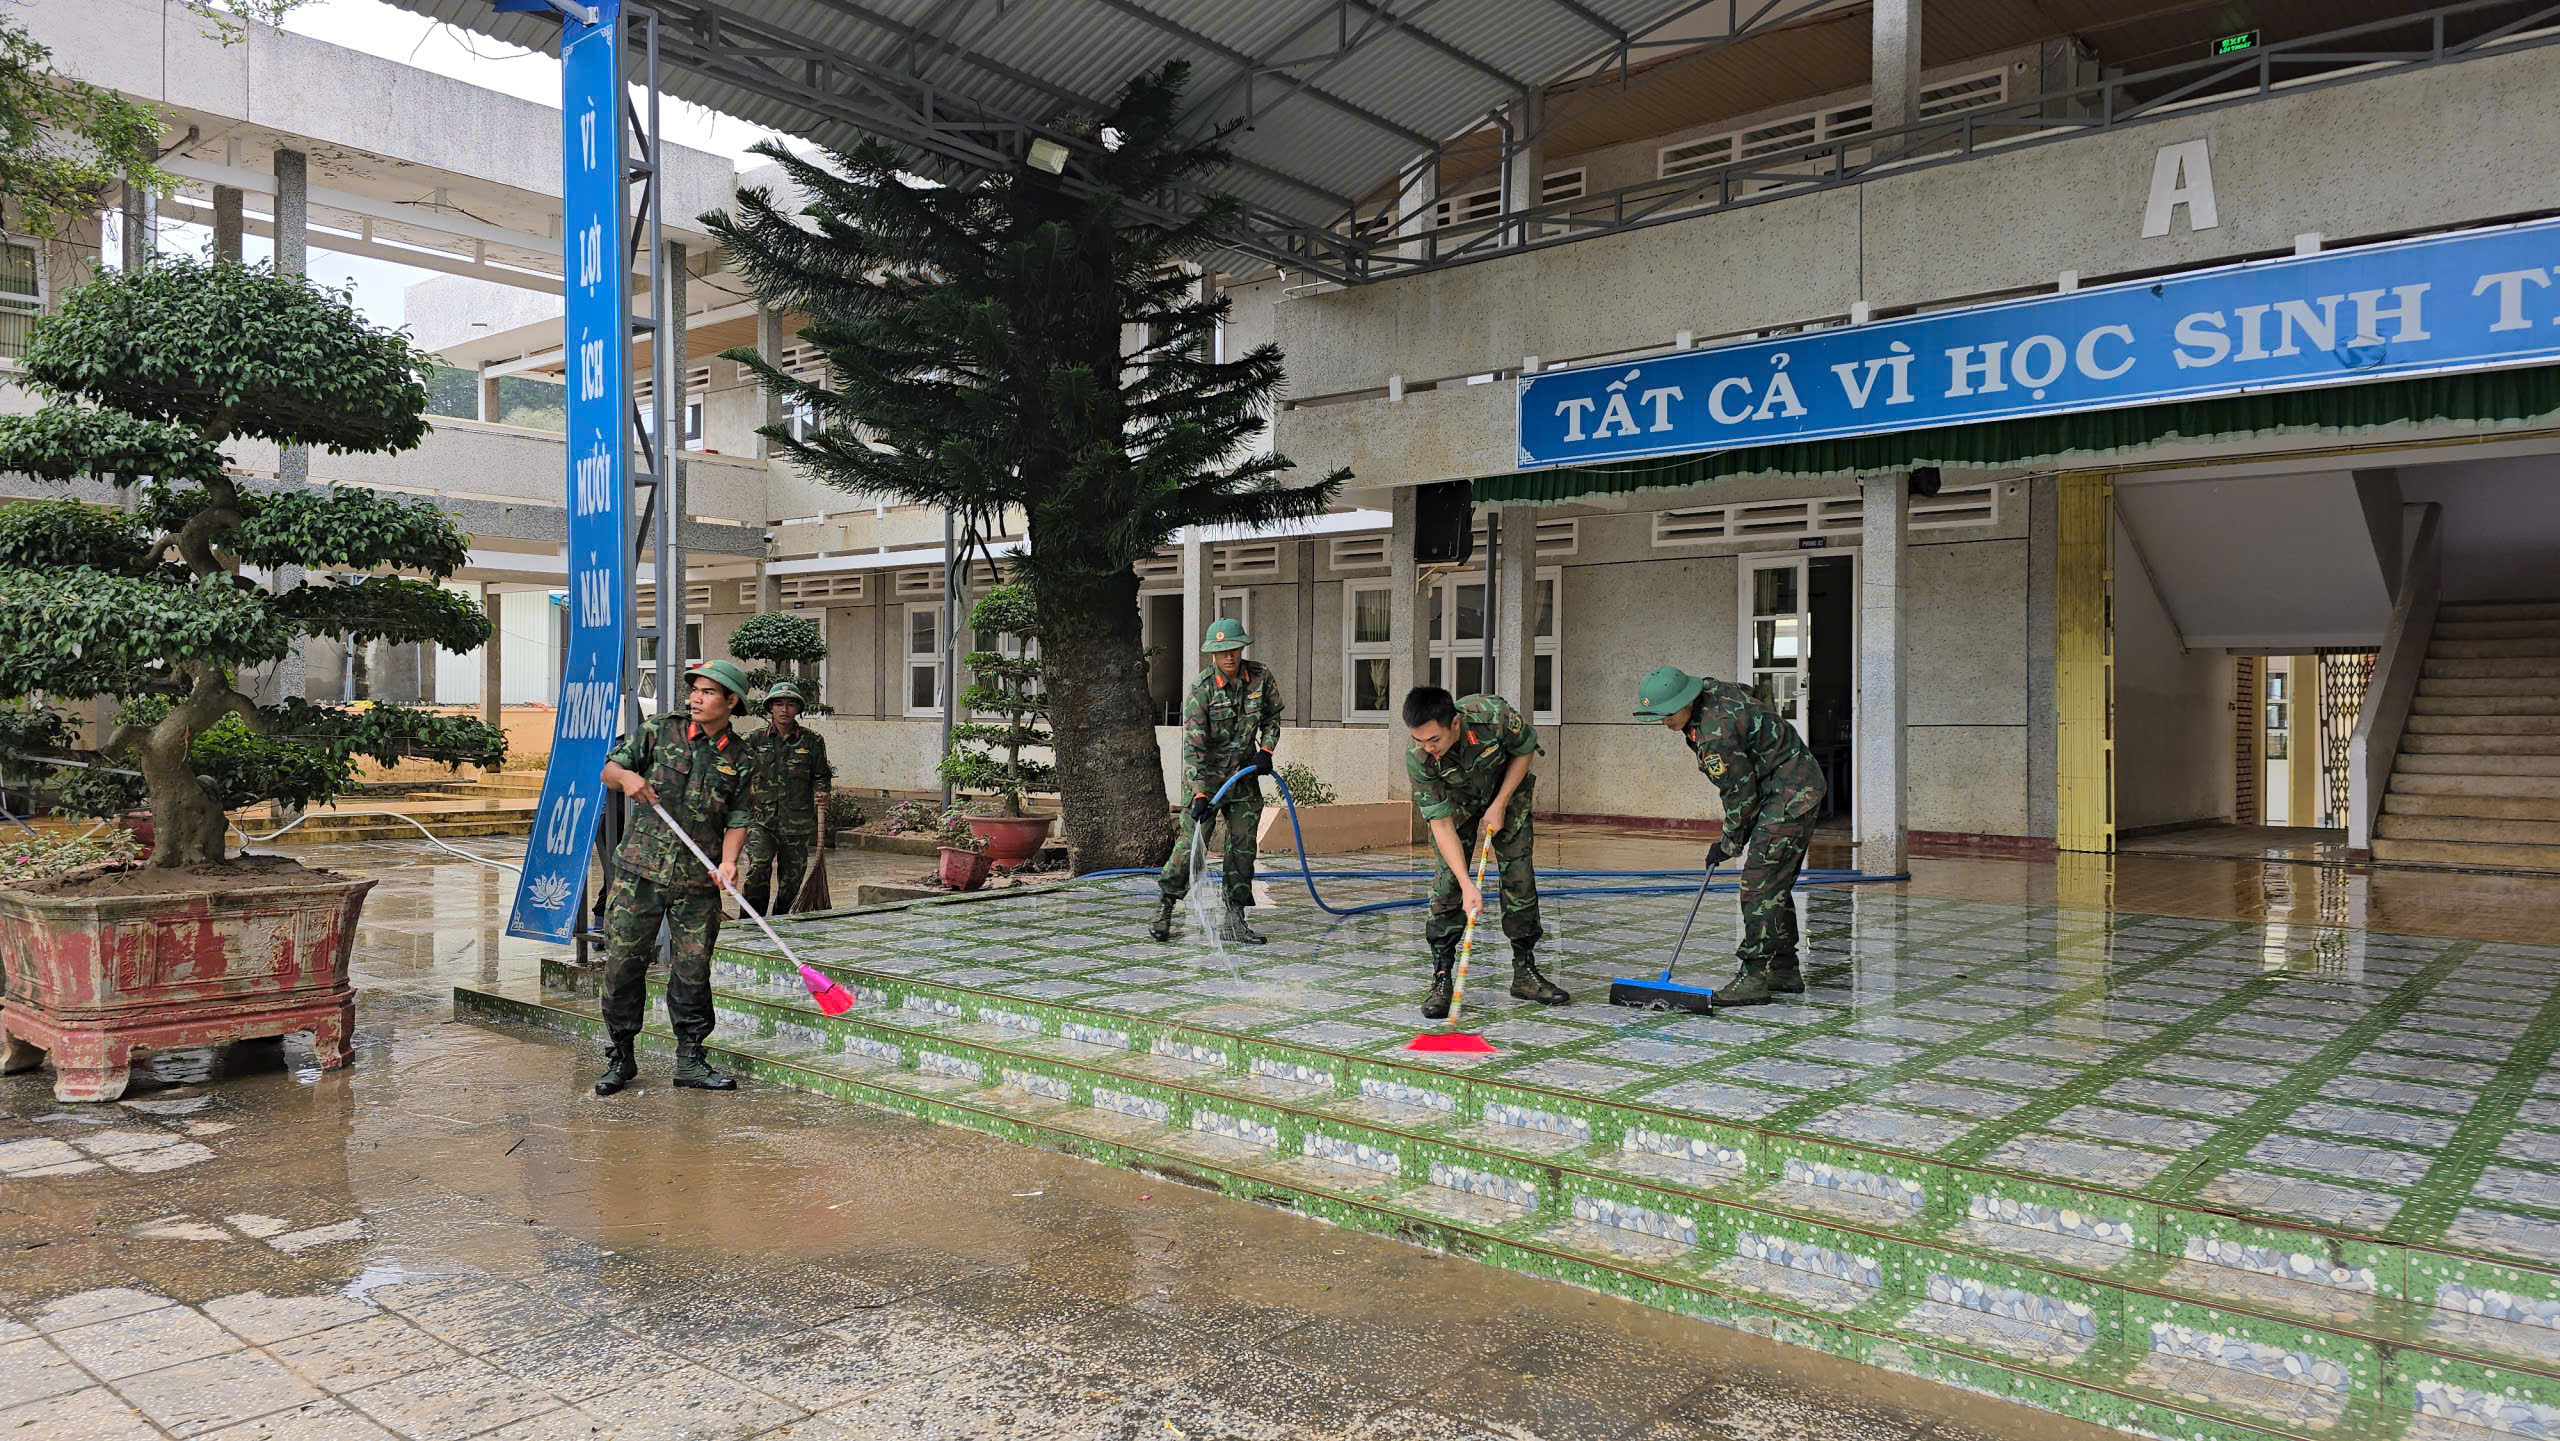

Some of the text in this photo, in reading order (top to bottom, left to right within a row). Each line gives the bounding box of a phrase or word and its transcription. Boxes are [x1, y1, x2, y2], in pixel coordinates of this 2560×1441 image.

[2222, 34, 2248, 48] EXIT
[581, 96, 597, 171] VÌ
[2141, 138, 2219, 239] A
[580, 213, 601, 298] LỢI
[581, 327, 604, 401] ÍCH
[1555, 265, 2560, 442] TẤT CẢ VÌ HỌC SINH T
[577, 427, 611, 516] MƯỜI
[581, 550, 611, 628] NĂM
[562, 652, 614, 740] TRỒNG
[546, 781, 586, 855] CÂY
